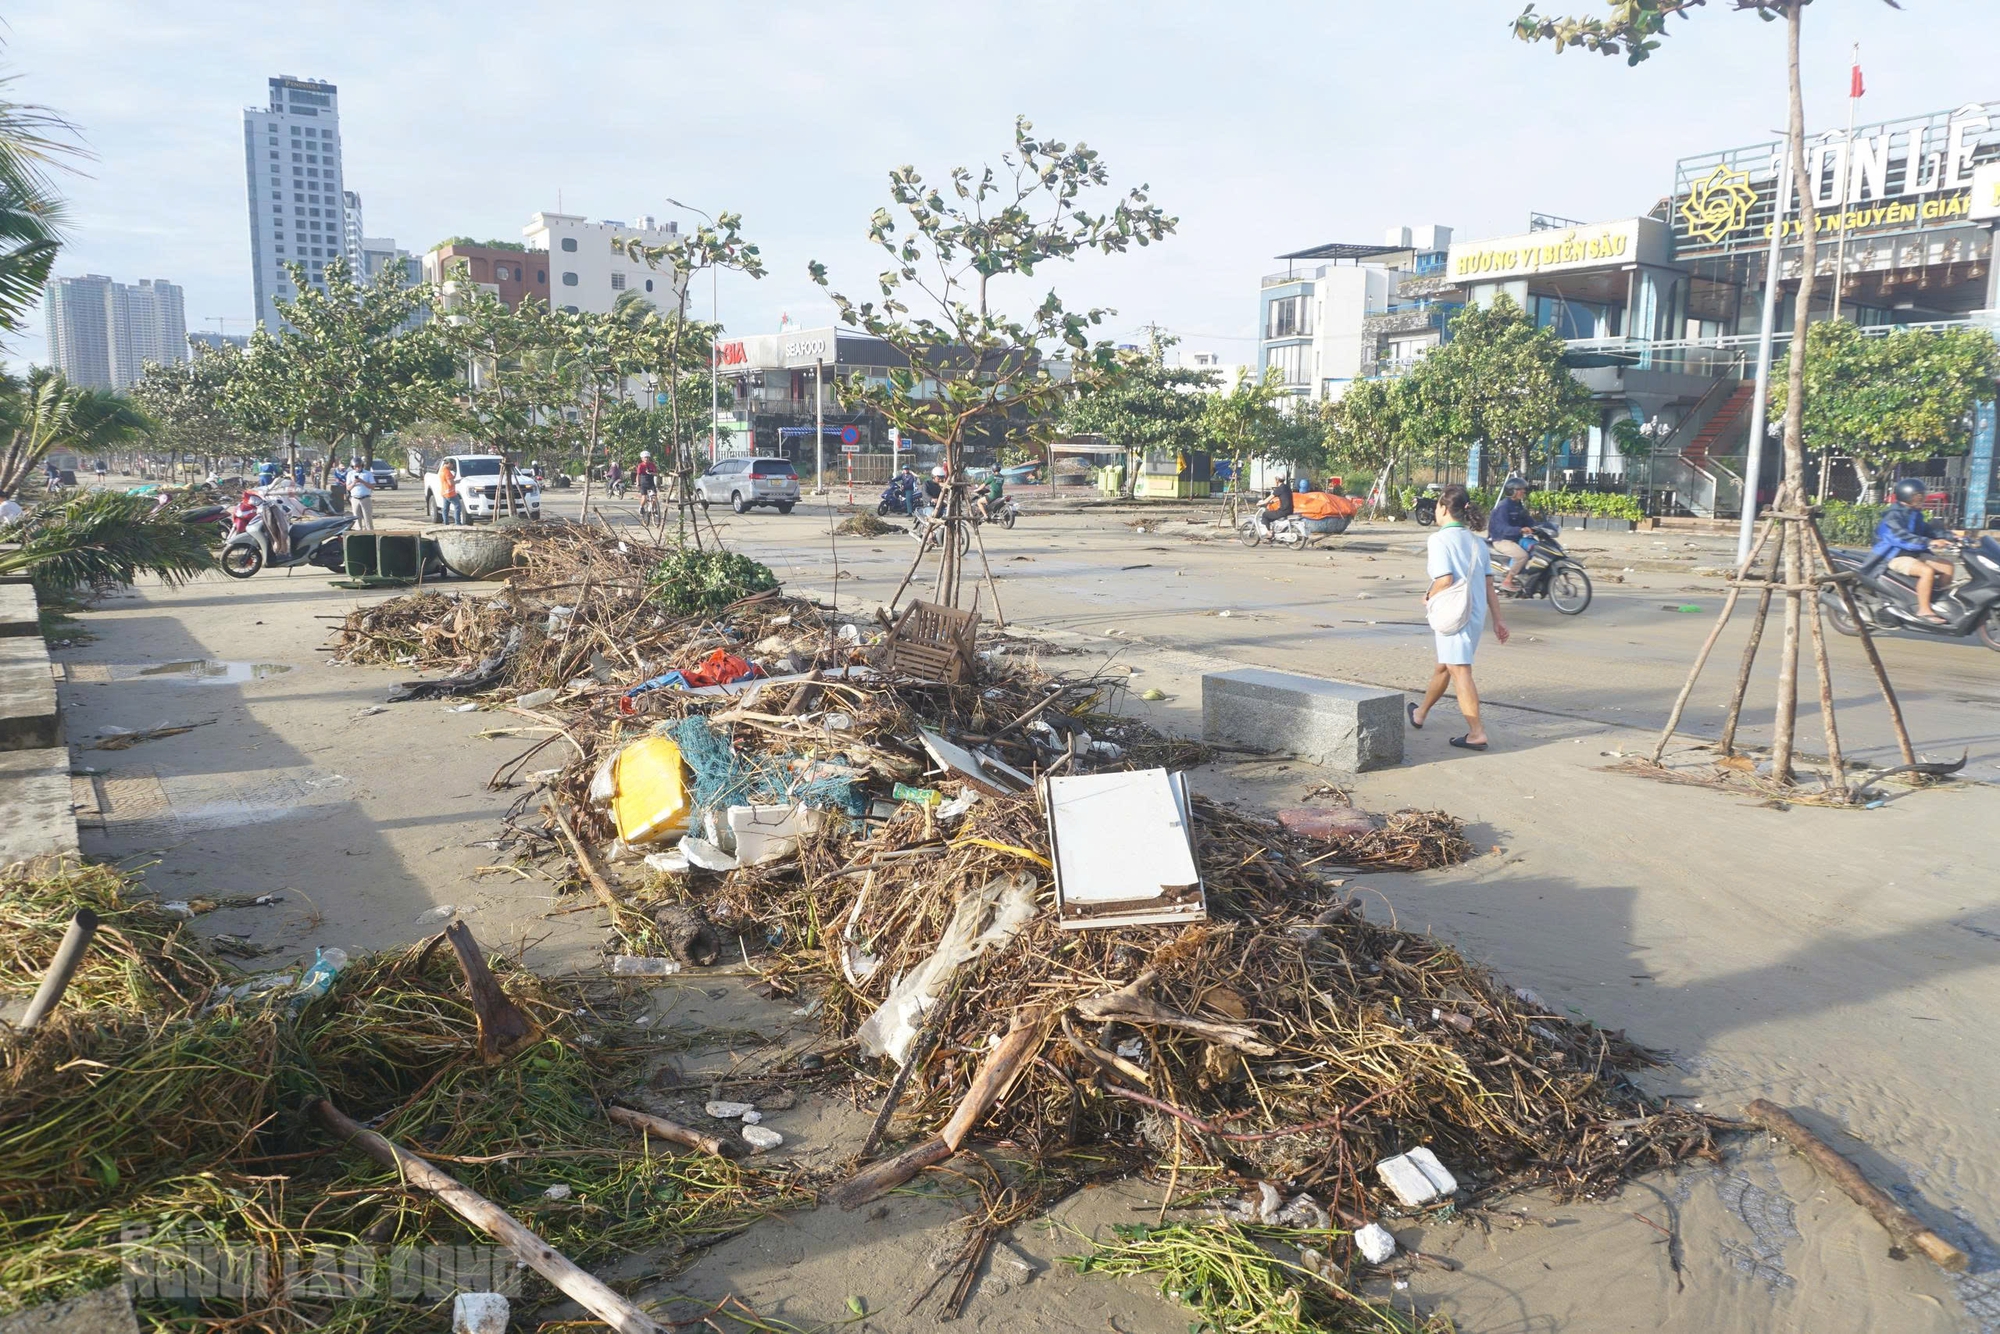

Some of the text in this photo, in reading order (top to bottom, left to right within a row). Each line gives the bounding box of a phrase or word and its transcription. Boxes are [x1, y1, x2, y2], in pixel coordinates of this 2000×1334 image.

[1827, 201, 1916, 231] NGUYÊN
[1520, 247, 1541, 272] VỊ
[785, 339, 826, 358] SEAFOOD
